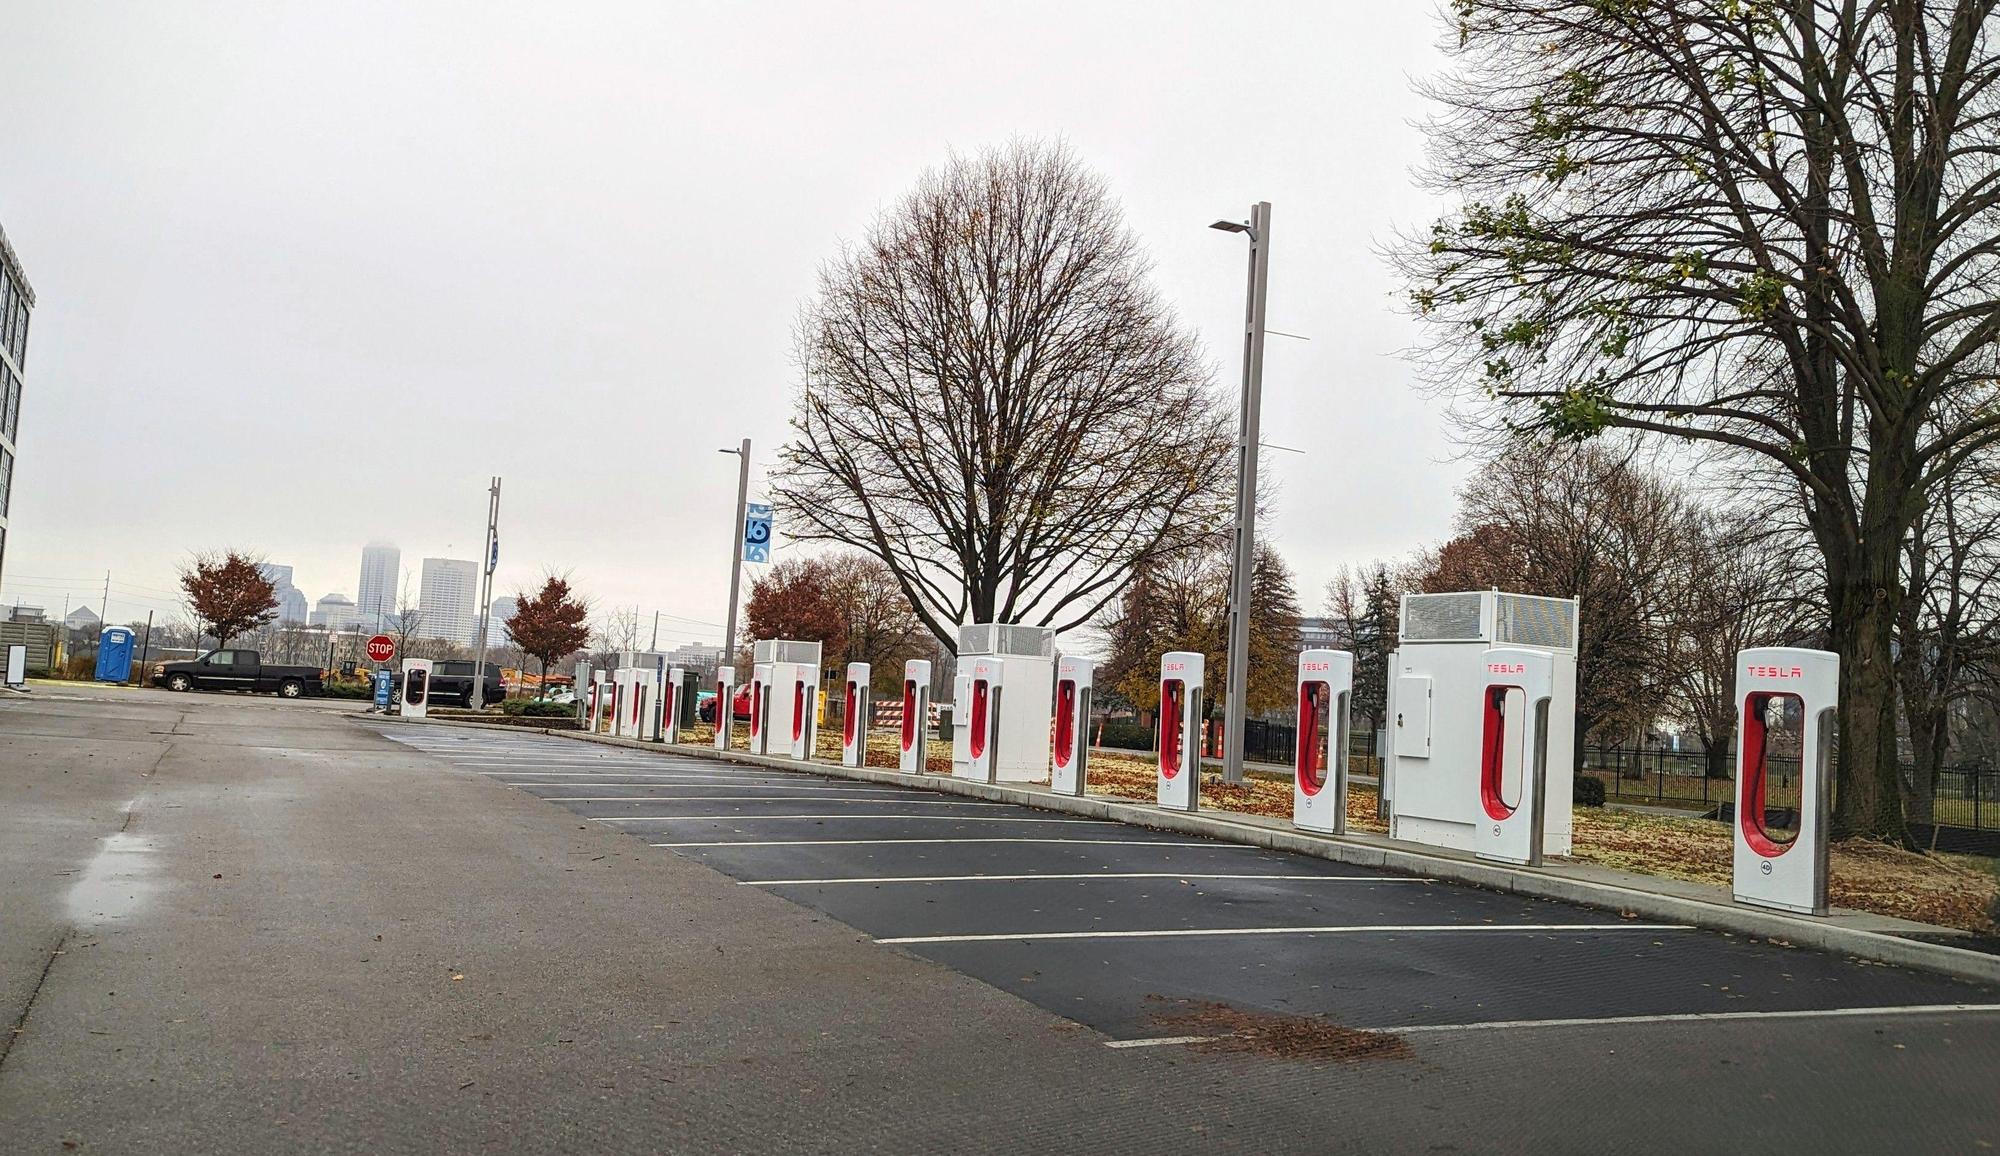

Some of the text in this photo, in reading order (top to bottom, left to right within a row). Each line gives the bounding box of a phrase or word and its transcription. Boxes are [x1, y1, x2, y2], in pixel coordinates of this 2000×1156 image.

[369, 643, 393, 655] STOP
[1302, 663, 1329, 671] TESLA
[1488, 664, 1524, 673] TESLA
[1748, 666, 1801, 678] TESLA
